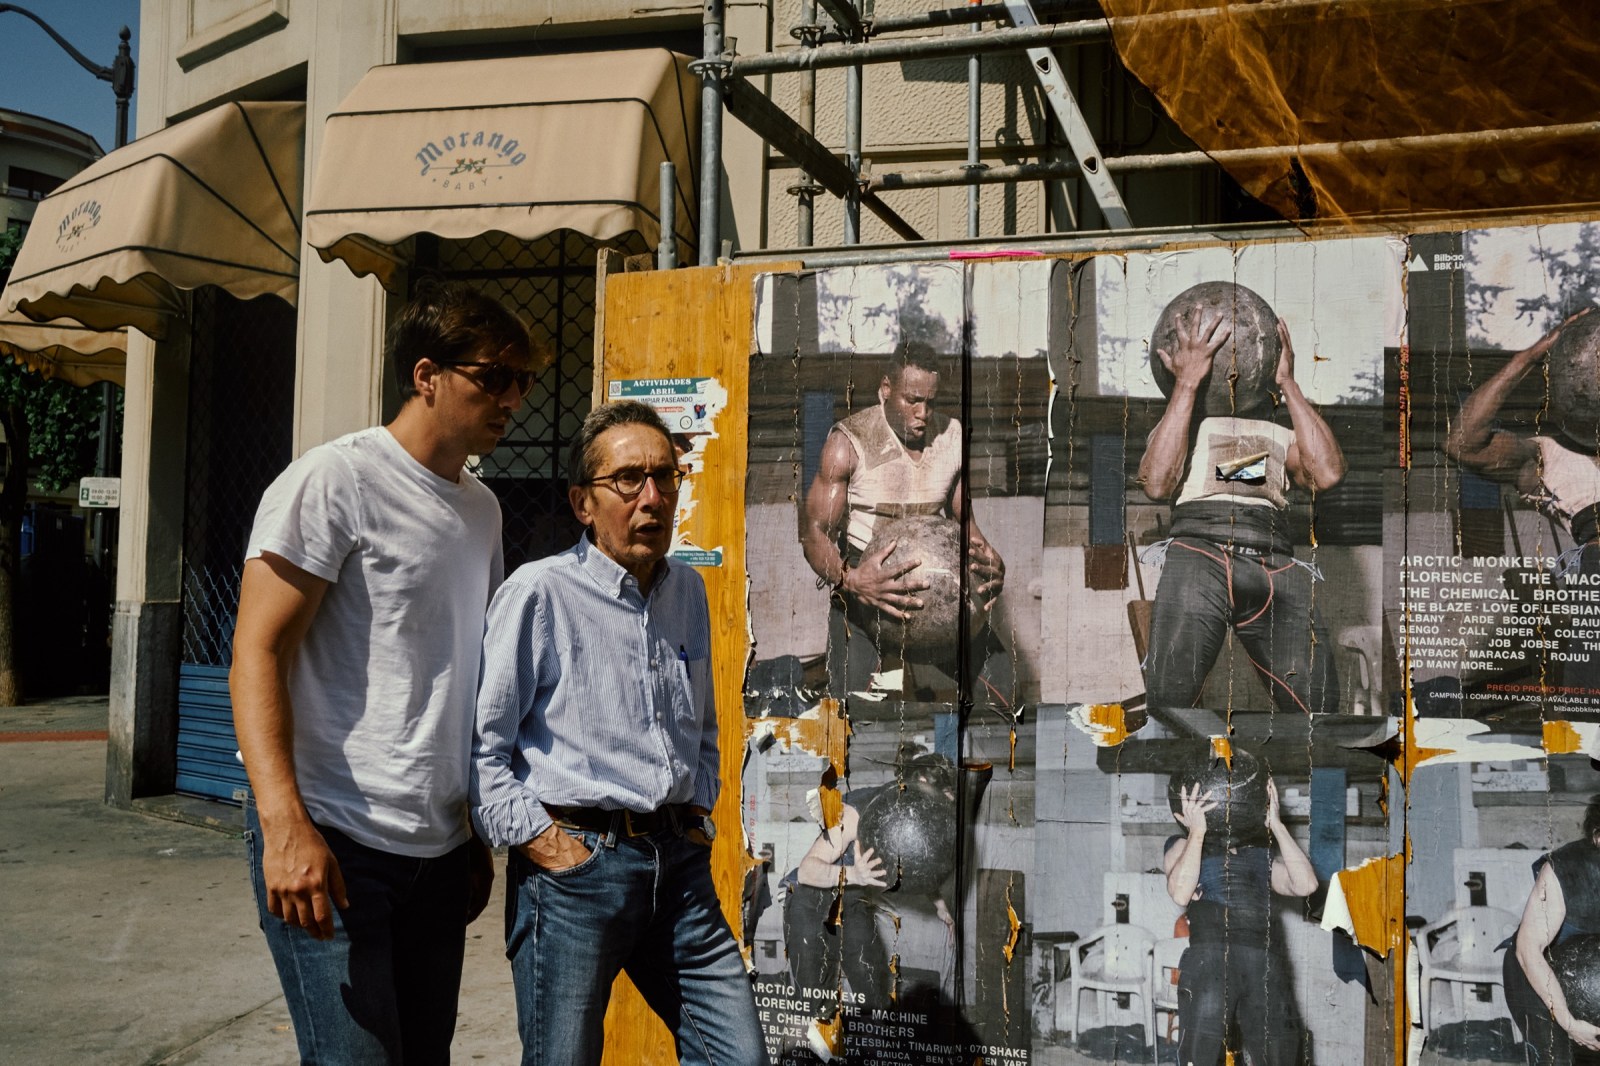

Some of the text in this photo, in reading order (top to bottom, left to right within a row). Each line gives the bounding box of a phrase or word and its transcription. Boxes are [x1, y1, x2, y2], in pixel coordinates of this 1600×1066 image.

[442, 178, 488, 190] BABY
[1434, 254, 1464, 262] Bilbao
[1434, 262, 1452, 270] BBK
[634, 378, 692, 387] ACTIVIDADES
[1400, 556, 1556, 568] ARCTIC MONKEYS
[1400, 571, 1483, 584] FLORENCE
[1520, 573, 1550, 584] THE
[1564, 574, 1600, 586] MAC
[1400, 587, 1600, 602] THE CHEMICAL BROTHE
[1399, 602, 1600, 615] THE BLAZE LOVE OF LESBIAN
[1400, 614, 1444, 622] ALBANY
[1463, 616, 1494, 624] ARDE
[1502, 615, 1552, 626] BOGOTÁ
[1400, 626, 1440, 634] BENGO
[1458, 626, 1488, 636] CALL
[1496, 628, 1534, 636] SUPER
[1400, 636, 1466, 646] DINAMARCA
[1488, 638, 1511, 648] JOB
[1520, 640, 1560, 650] JOBSE
[1399, 648, 1590, 662] PLAYBACK MARACAS ROJUU
[1426, 660, 1457, 669] MANY
[1461, 661, 1504, 671] MORE...
[1486, 684, 1520, 692] PRECIO
[1558, 686, 1585, 694] PRICE
[1430, 692, 1464, 700] CAMPING
[802, 987, 866, 1004] MONKEYS
[755, 996, 810, 1012] LORENCE
[872, 1008, 928, 1025] MACHINE
[848, 1021, 915, 1038] BROTHERS
[770, 1025, 802, 1038] BLAZE
[856, 1037, 900, 1049] LESBIAN
[908, 1041, 962, 1055] TINARIWN
[970, 1044, 988, 1054] 070
[990, 1046, 1028, 1059] SHAKE
[792, 1050, 813, 1058] CALL
[876, 1050, 910, 1060] BAIUCA
[926, 1055, 944, 1065] BEN
